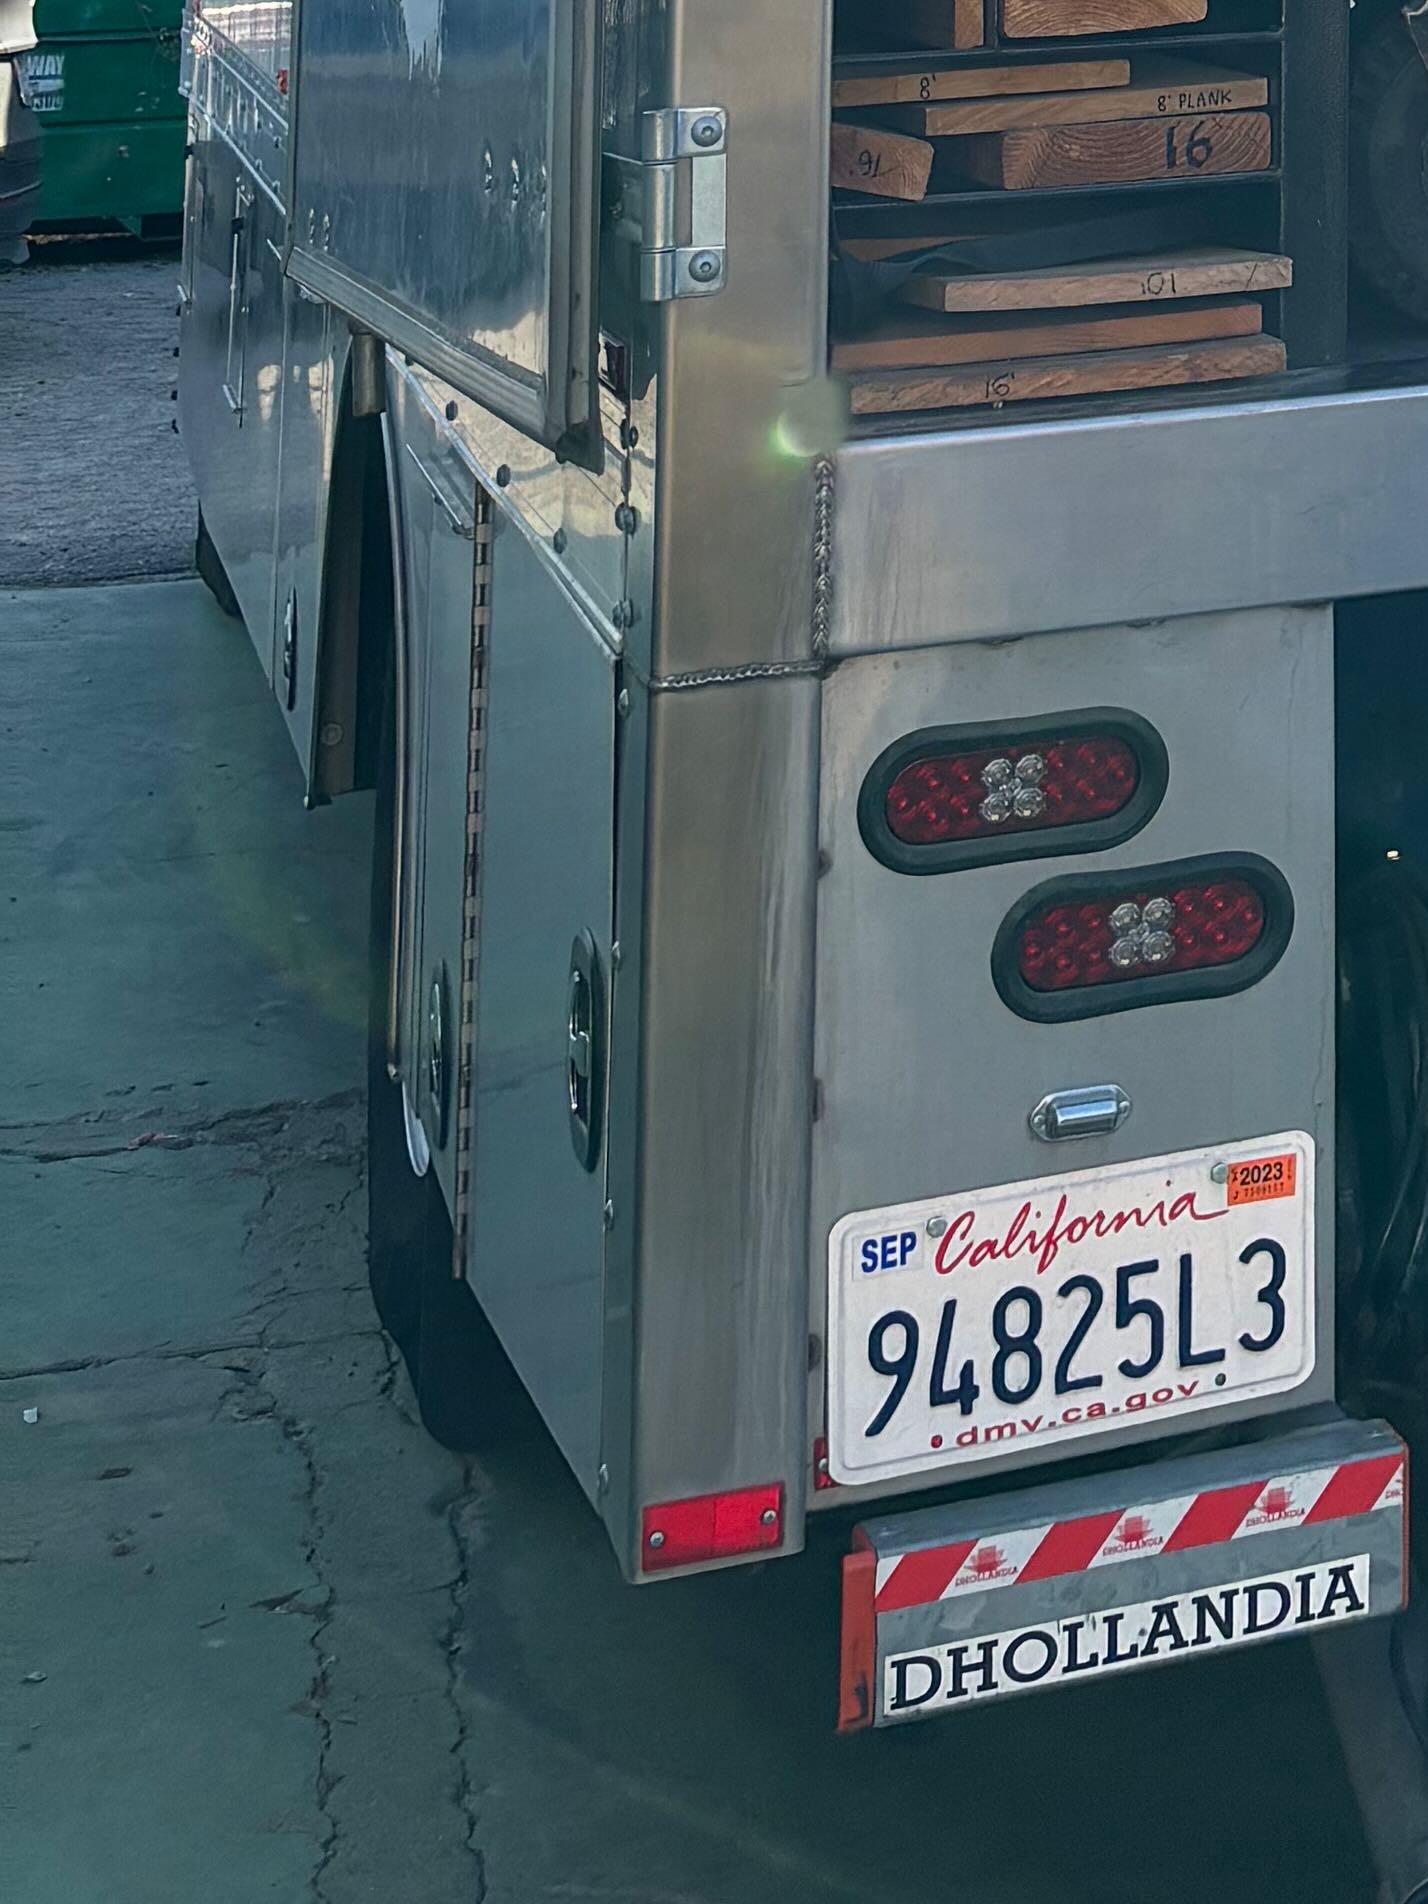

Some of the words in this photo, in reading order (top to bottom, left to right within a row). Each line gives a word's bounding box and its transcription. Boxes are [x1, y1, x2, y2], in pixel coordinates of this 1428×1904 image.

[1178, 88, 1233, 110] PLANK
[1164, 121, 1213, 170] 16
[1239, 1161, 1284, 1186] 2023
[860, 1229, 918, 1274] SEP
[934, 1180, 1231, 1275] California
[863, 1237, 1287, 1438] 94825L3
[955, 1378, 1201, 1450] dmv.ca.gov
[888, 1561, 1367, 1712] DHOLLANDIA
